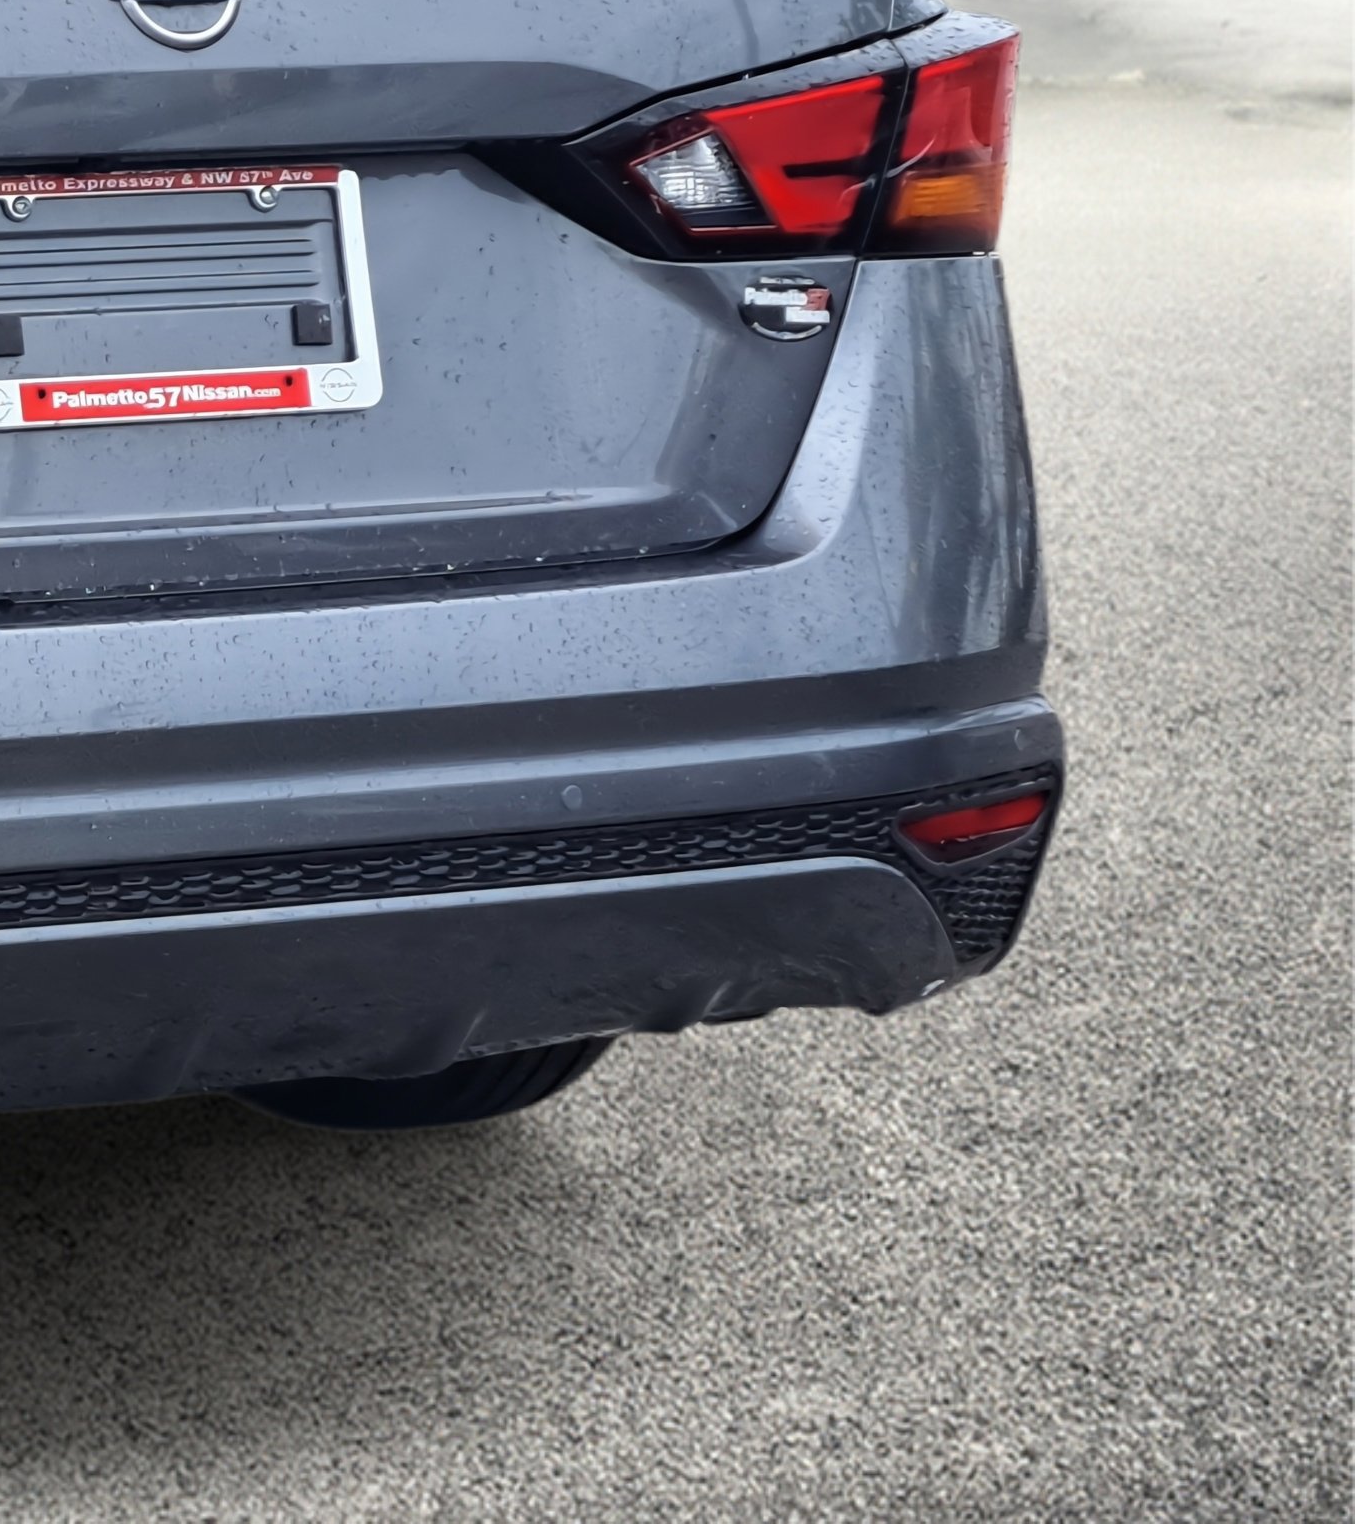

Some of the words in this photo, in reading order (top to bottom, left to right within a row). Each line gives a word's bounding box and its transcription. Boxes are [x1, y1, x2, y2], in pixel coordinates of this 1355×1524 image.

[62, 174, 176, 192] Expressway
[181, 173, 194, 186] &
[200, 170, 233, 185] NW
[279, 168, 314, 182] Ave
